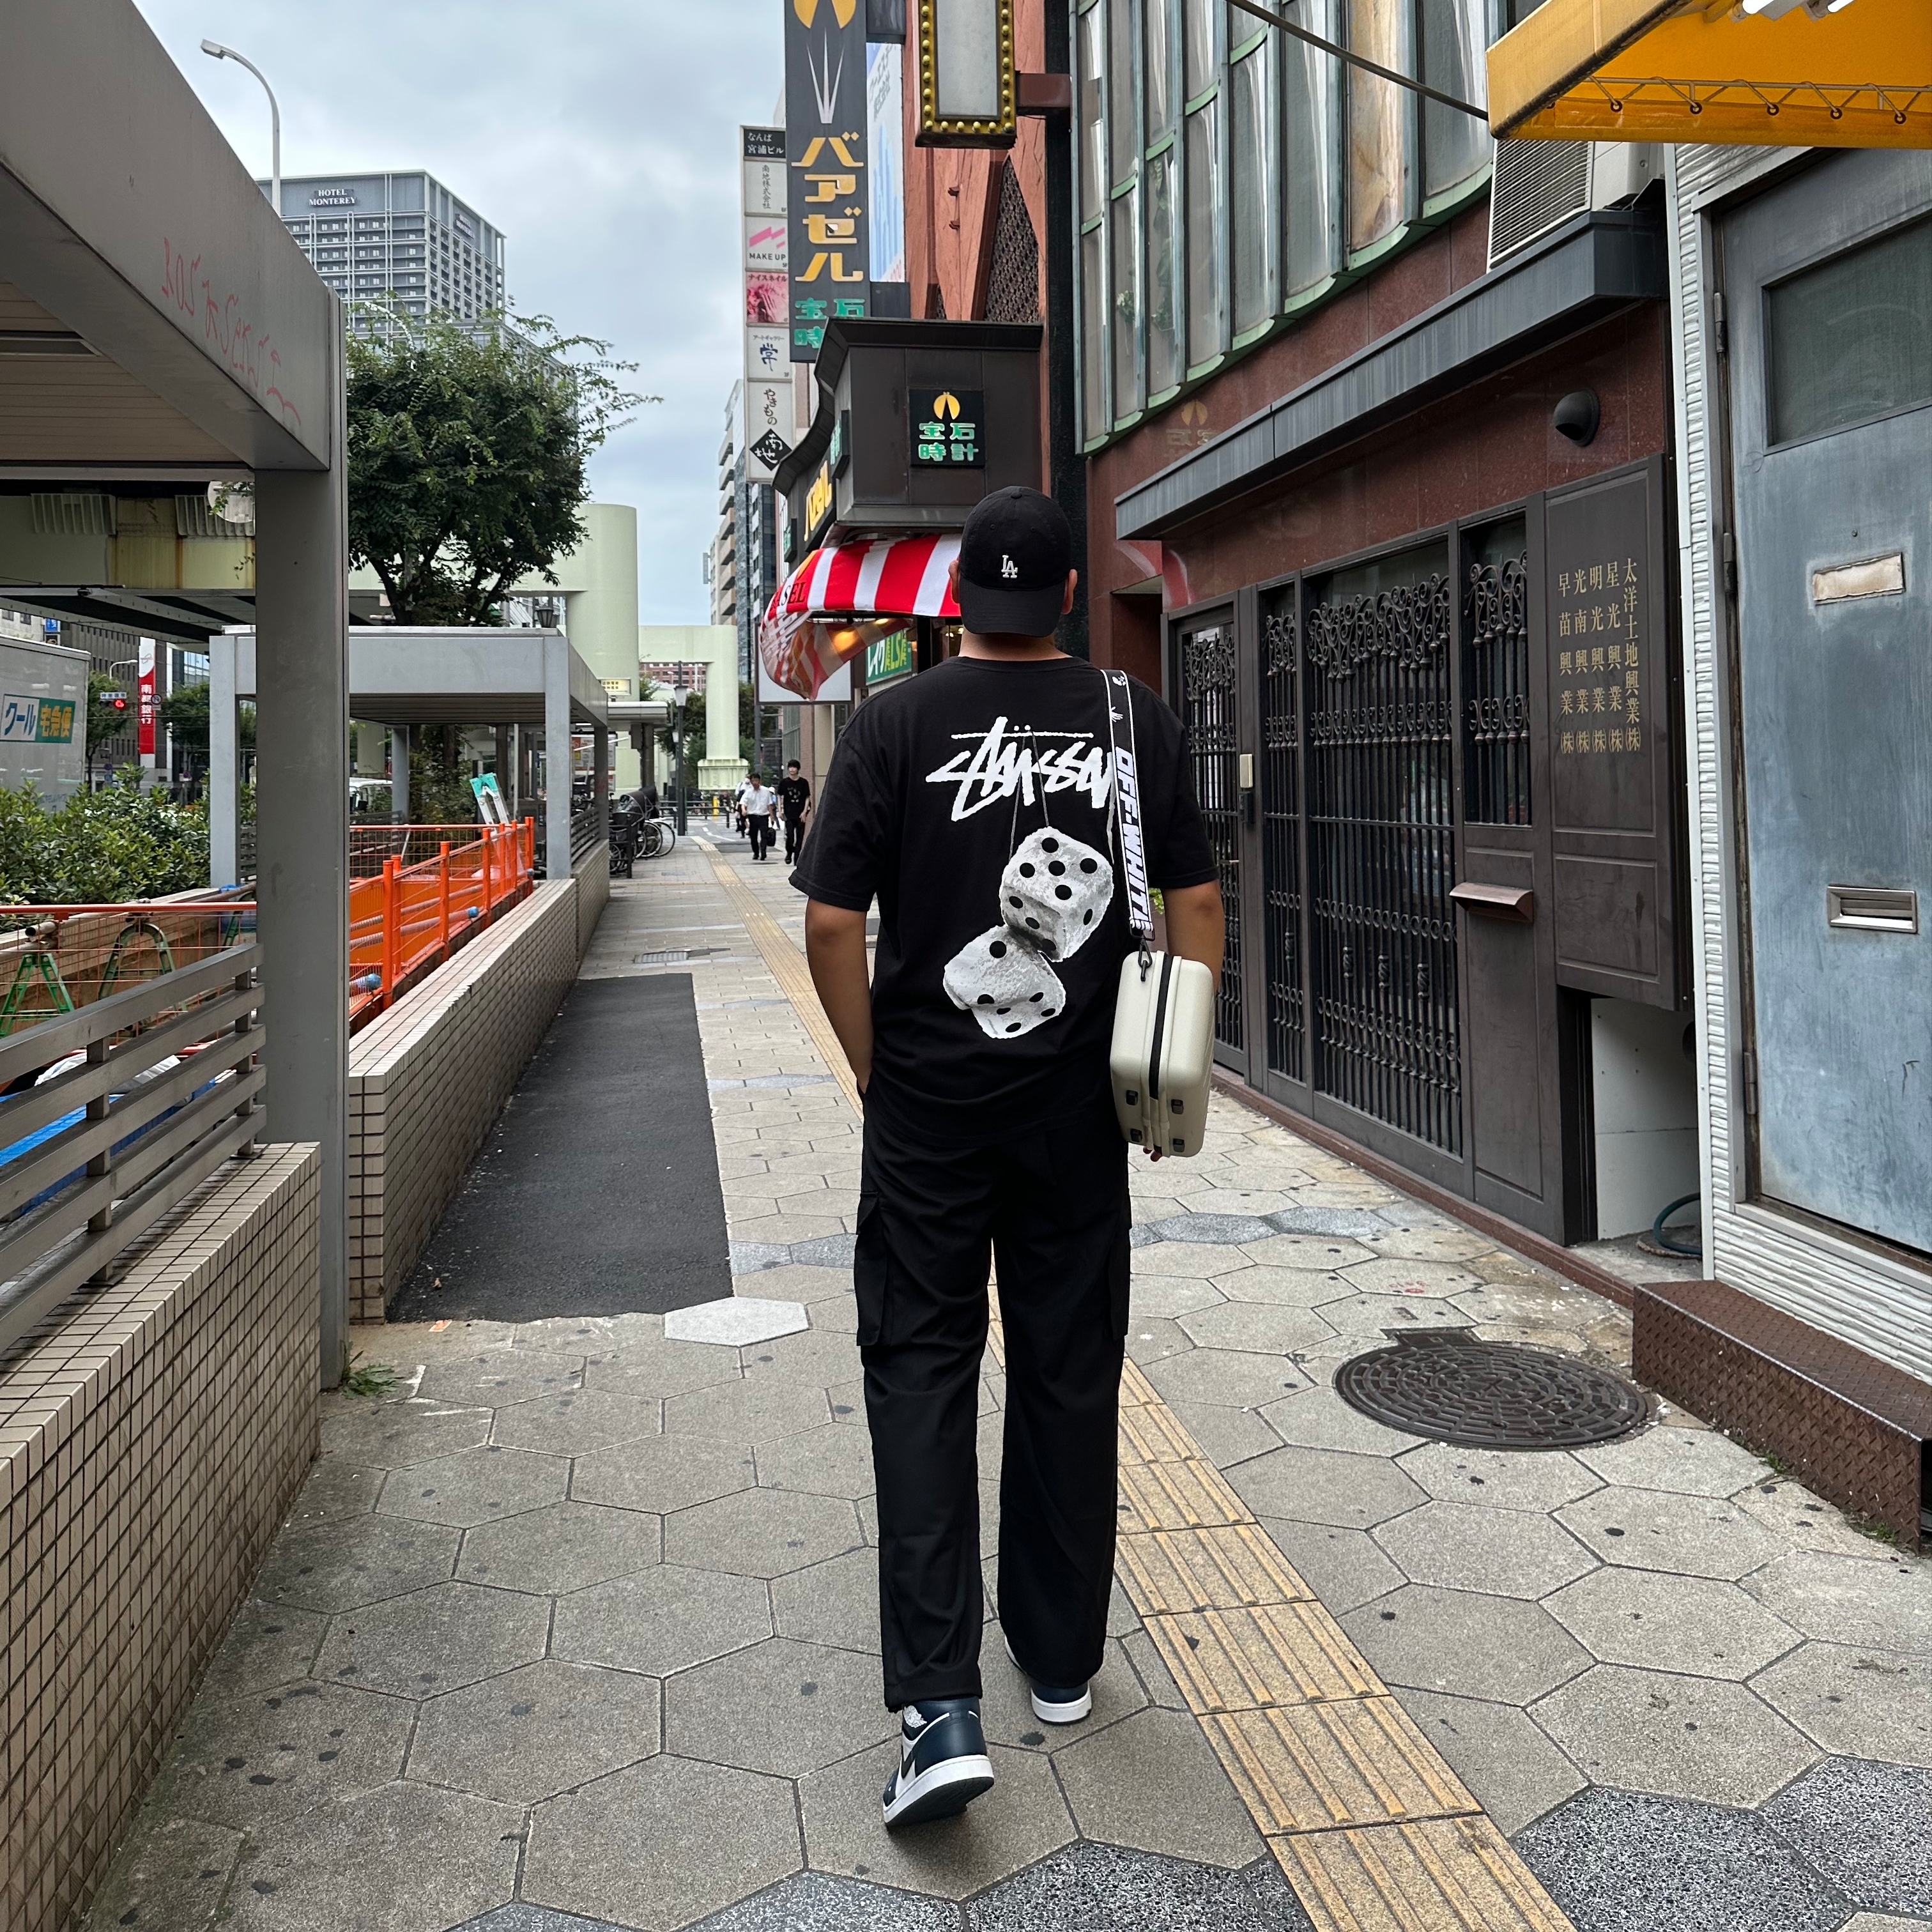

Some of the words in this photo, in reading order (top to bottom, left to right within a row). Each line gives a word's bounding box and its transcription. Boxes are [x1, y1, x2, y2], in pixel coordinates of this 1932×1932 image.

[747, 132, 772, 142] なんば
[309, 197, 355, 206] MONTEREY
[791, 131, 864, 282] バアゼル
[795, 298, 865, 319] 宝石
[763, 388, 778, 426] やきもの
[919, 421, 976, 440] 宝石
[918, 441, 979, 462] 時計
[1000, 555, 1018, 579] LA
[4, 702, 36, 736] クール
[40, 704, 72, 738] 宅急便
